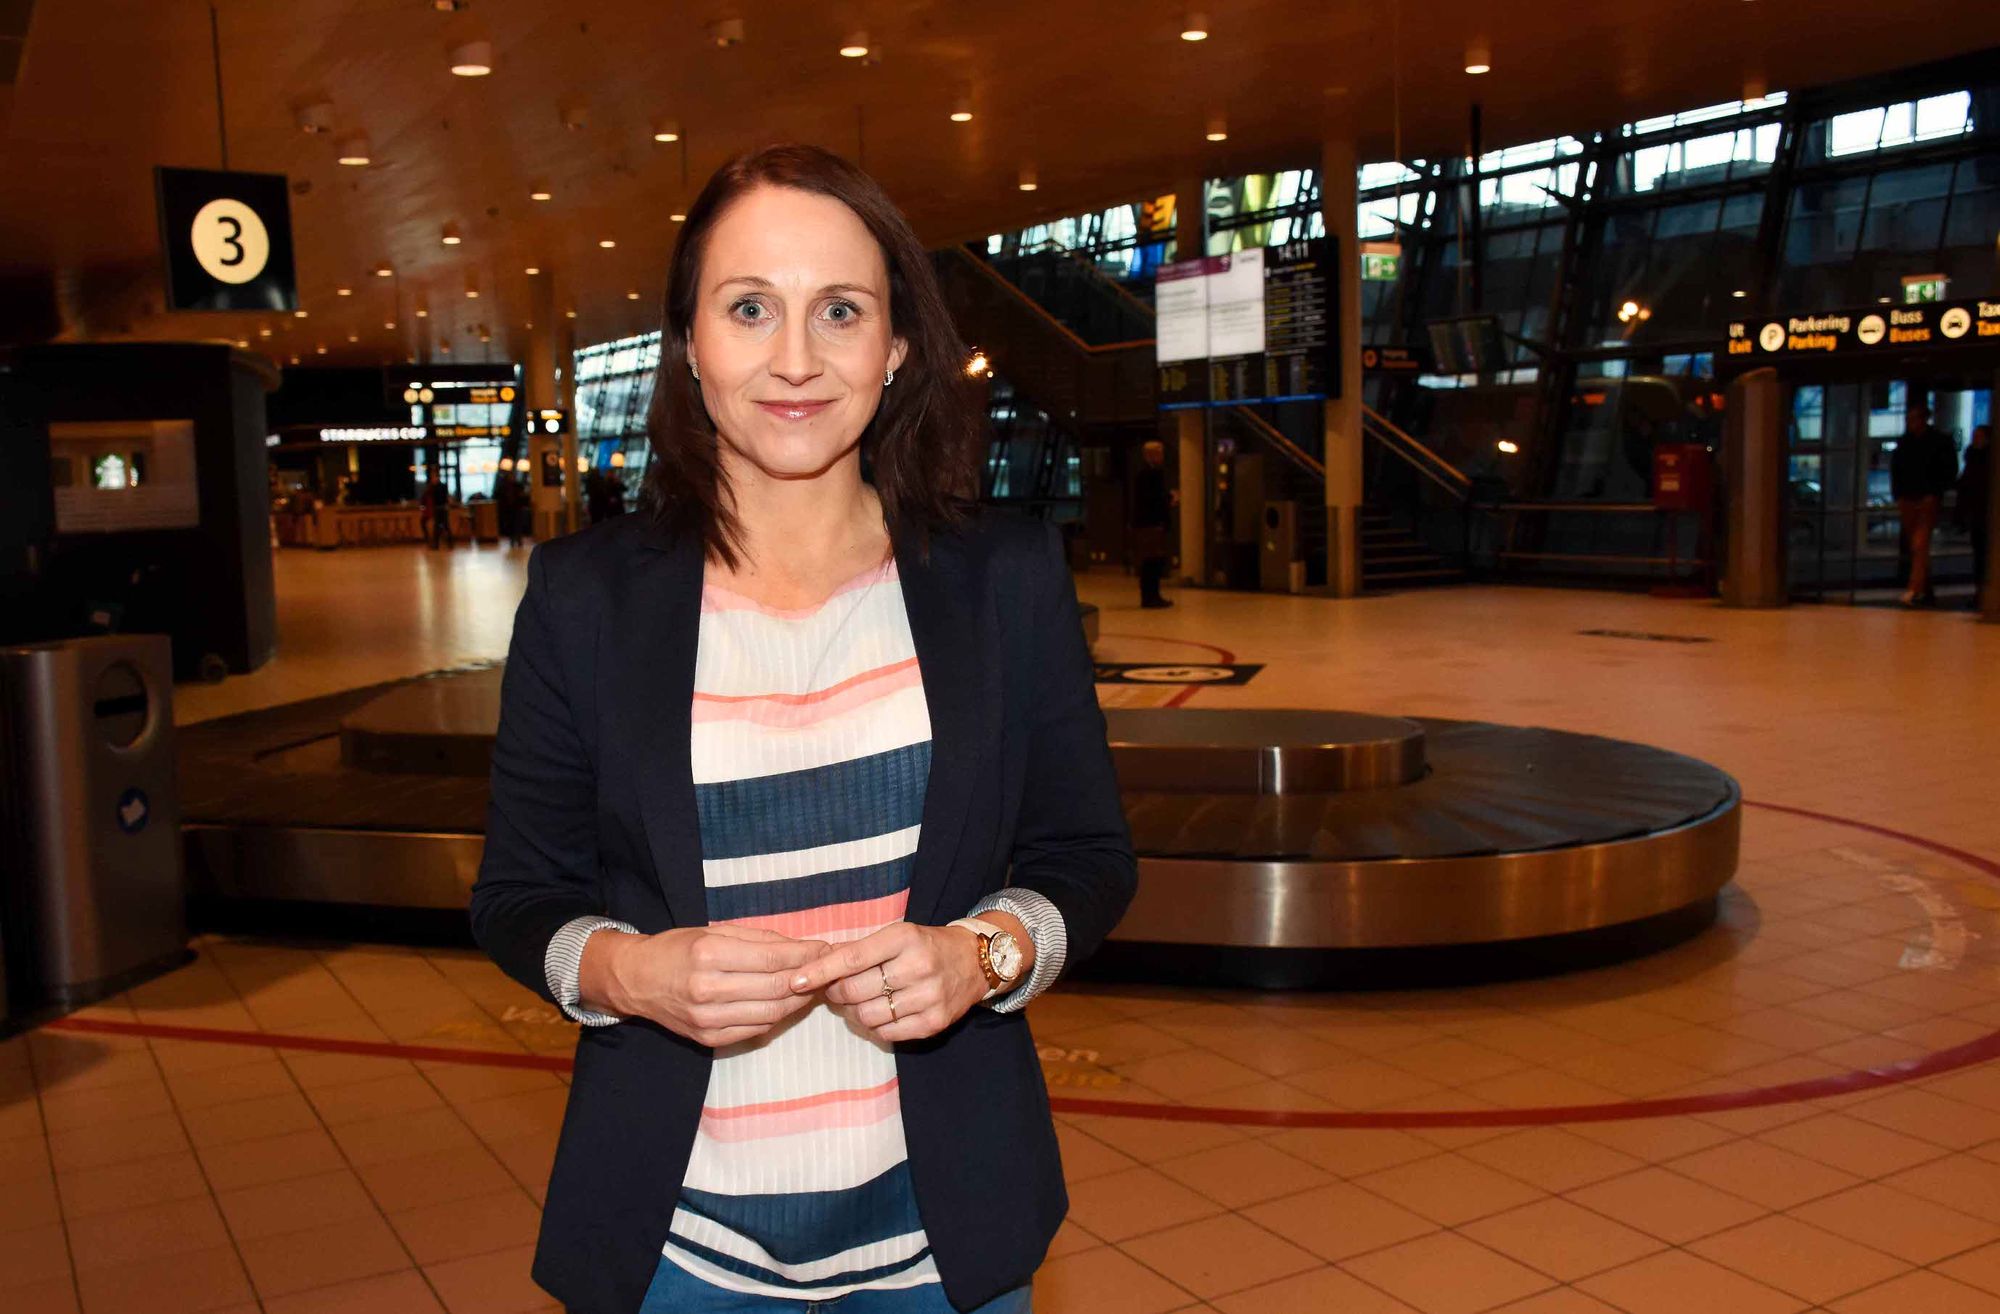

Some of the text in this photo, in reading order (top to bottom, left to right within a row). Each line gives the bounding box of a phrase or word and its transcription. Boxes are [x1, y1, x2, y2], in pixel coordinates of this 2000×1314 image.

[218, 216, 245, 266] 3
[1789, 314, 1850, 334] Parkering
[1890, 310, 1924, 325] Buss
[1788, 333, 1837, 351] Parking
[1890, 327, 1931, 343] Buses
[1729, 339, 1752, 354] Exit
